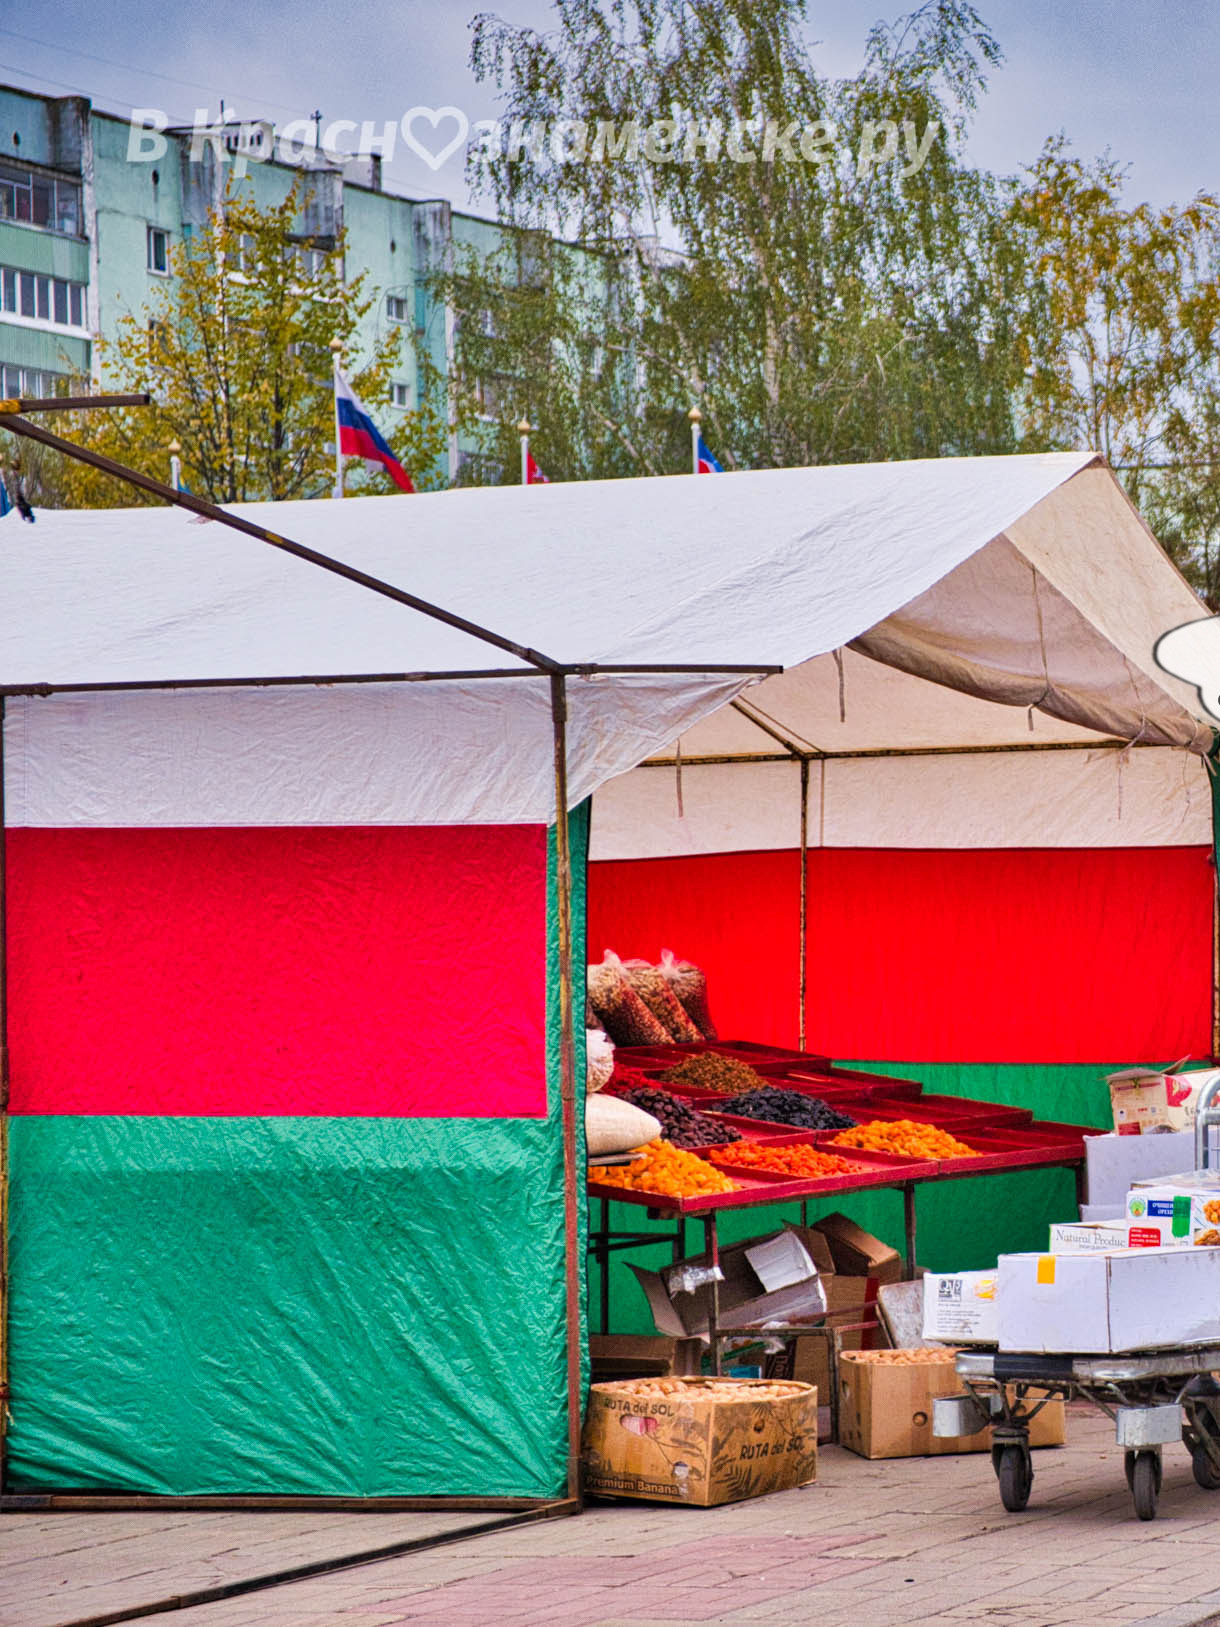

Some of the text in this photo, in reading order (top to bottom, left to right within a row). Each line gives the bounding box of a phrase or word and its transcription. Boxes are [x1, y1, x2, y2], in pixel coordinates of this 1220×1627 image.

[1056, 1229, 1091, 1244] Natural
[603, 1398, 674, 1417] RUTA del SOL
[738, 1436, 805, 1461] RUTA del SOL
[586, 1475, 635, 1491] Premium
